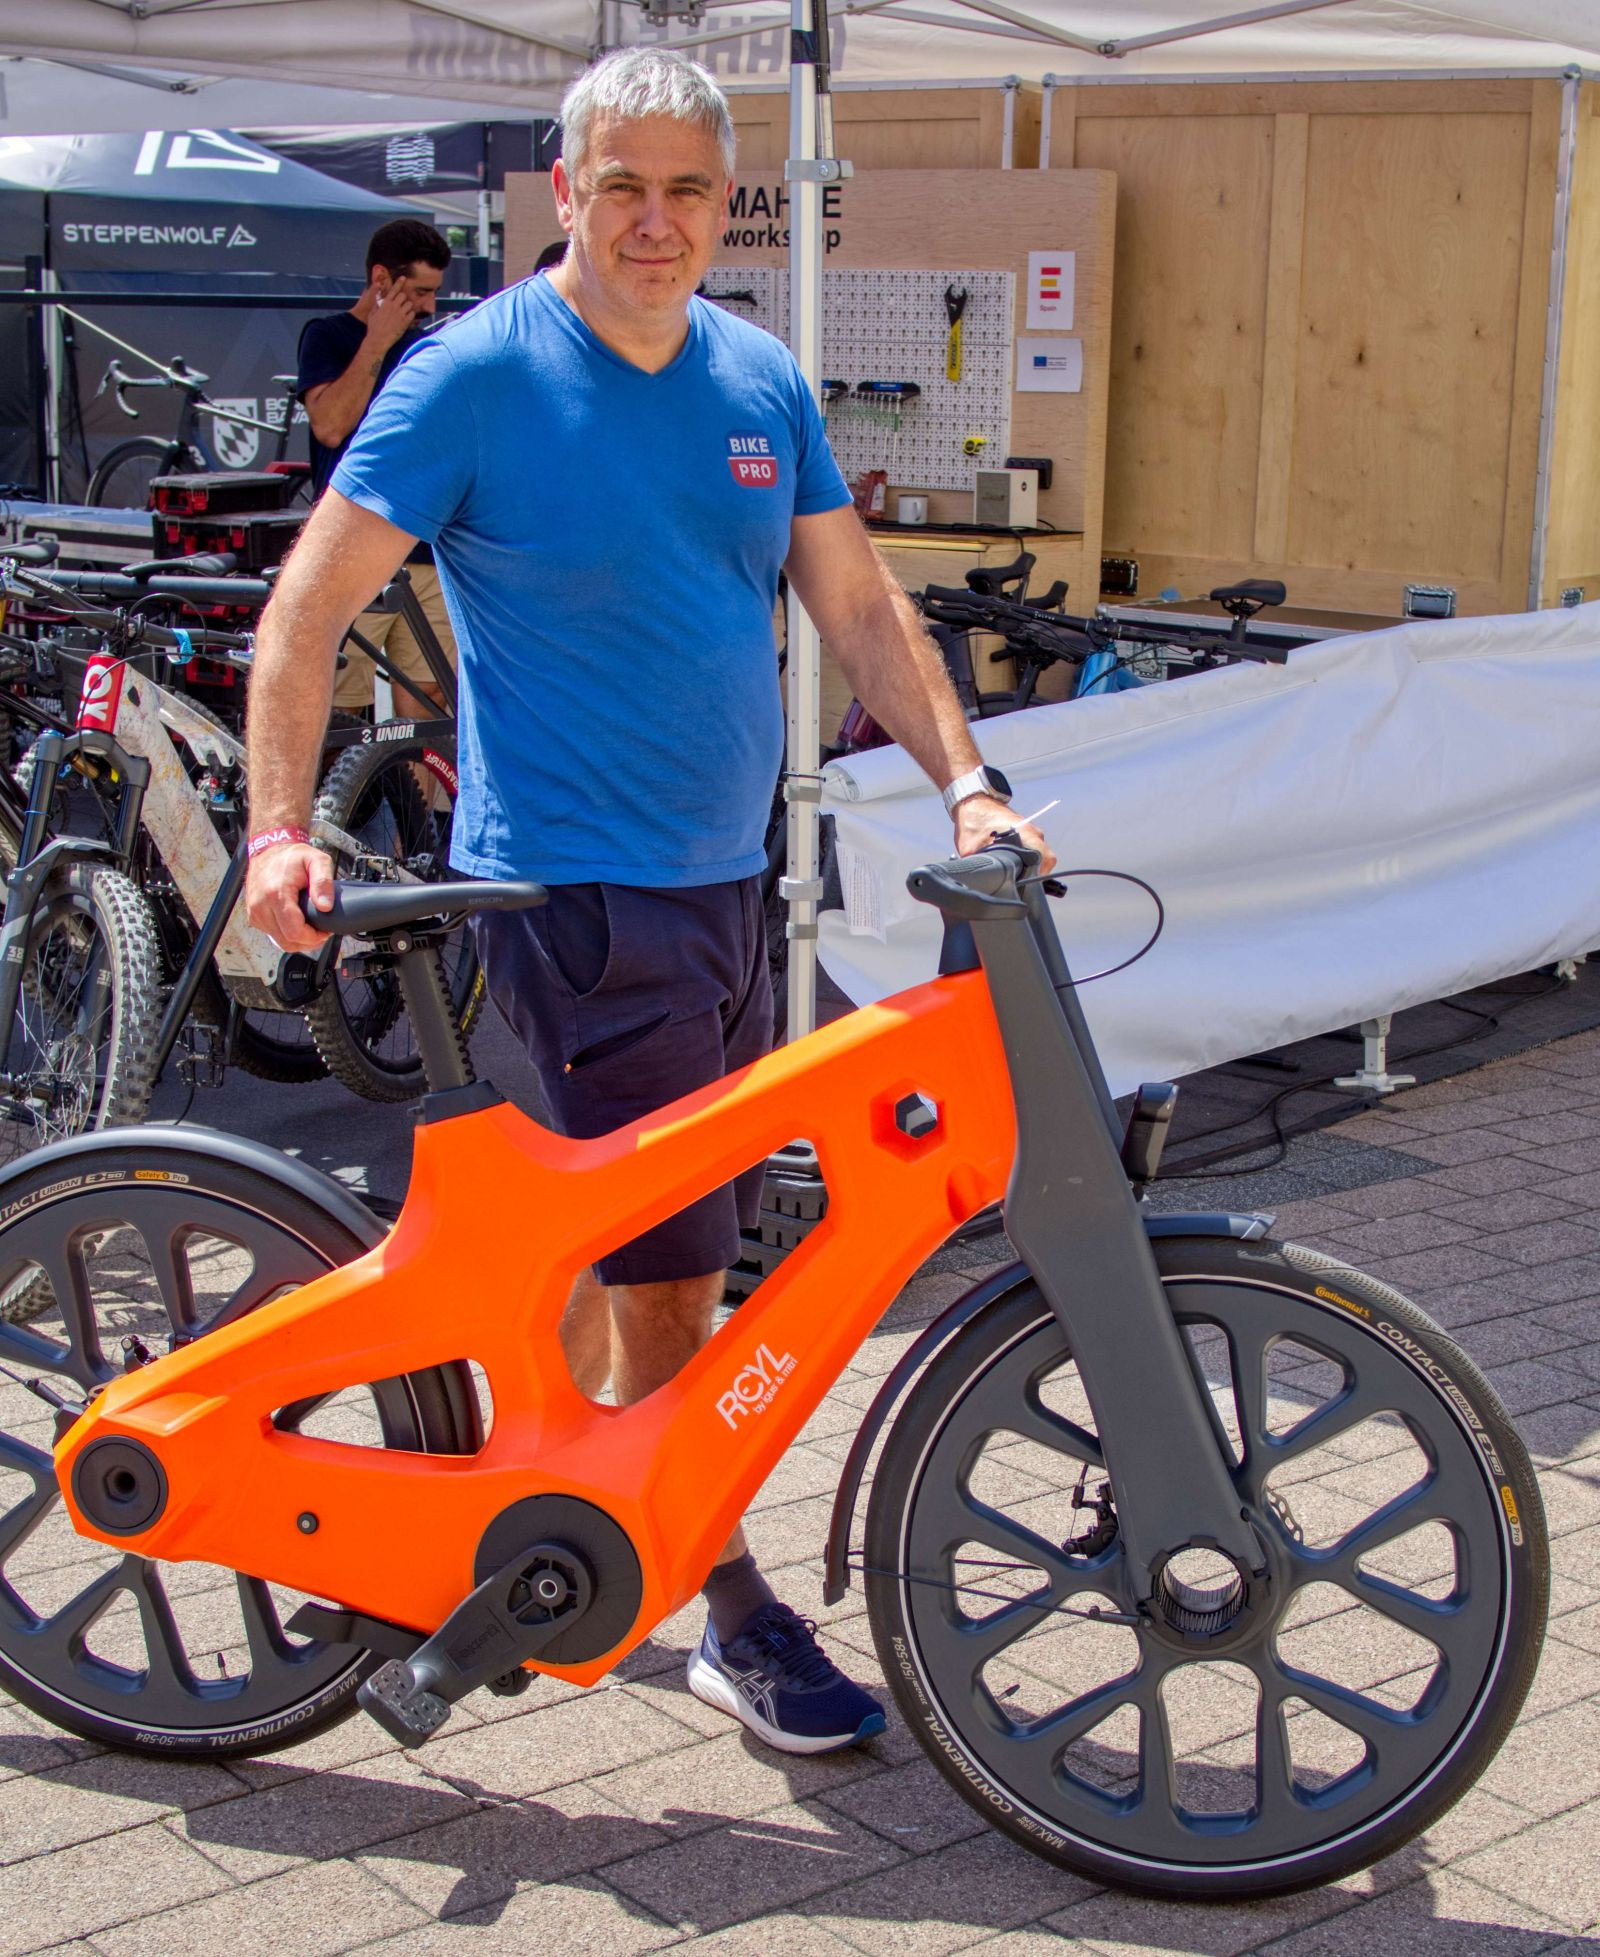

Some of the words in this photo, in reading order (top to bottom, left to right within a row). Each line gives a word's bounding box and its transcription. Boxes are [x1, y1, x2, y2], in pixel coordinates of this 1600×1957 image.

[728, 186, 842, 218] MAHE
[63, 224, 226, 244] STEPPENWOLF
[722, 223, 841, 254] worksp
[729, 437, 770, 454] BIKE
[739, 463, 771, 479] PRO
[376, 724, 415, 742] UNIOR
[172, 1174, 187, 1182] Pro
[0, 1191, 41, 1222] TACT
[42, 1178, 81, 1197] URBAN
[1315, 1285, 1366, 1315] Continental
[715, 1342, 791, 1431] RCYL
[1377, 1321, 1453, 1386] CONTACT
[1449, 1387, 1481, 1427] URBAN
[752, 1401, 767, 1414] by
[761, 1384, 778, 1404] igus
[1513, 1527, 1521, 1543] Pro
[209, 1704, 315, 1747] CONTINENTAL
[924, 1711, 1013, 1814] CONTINENTAL
